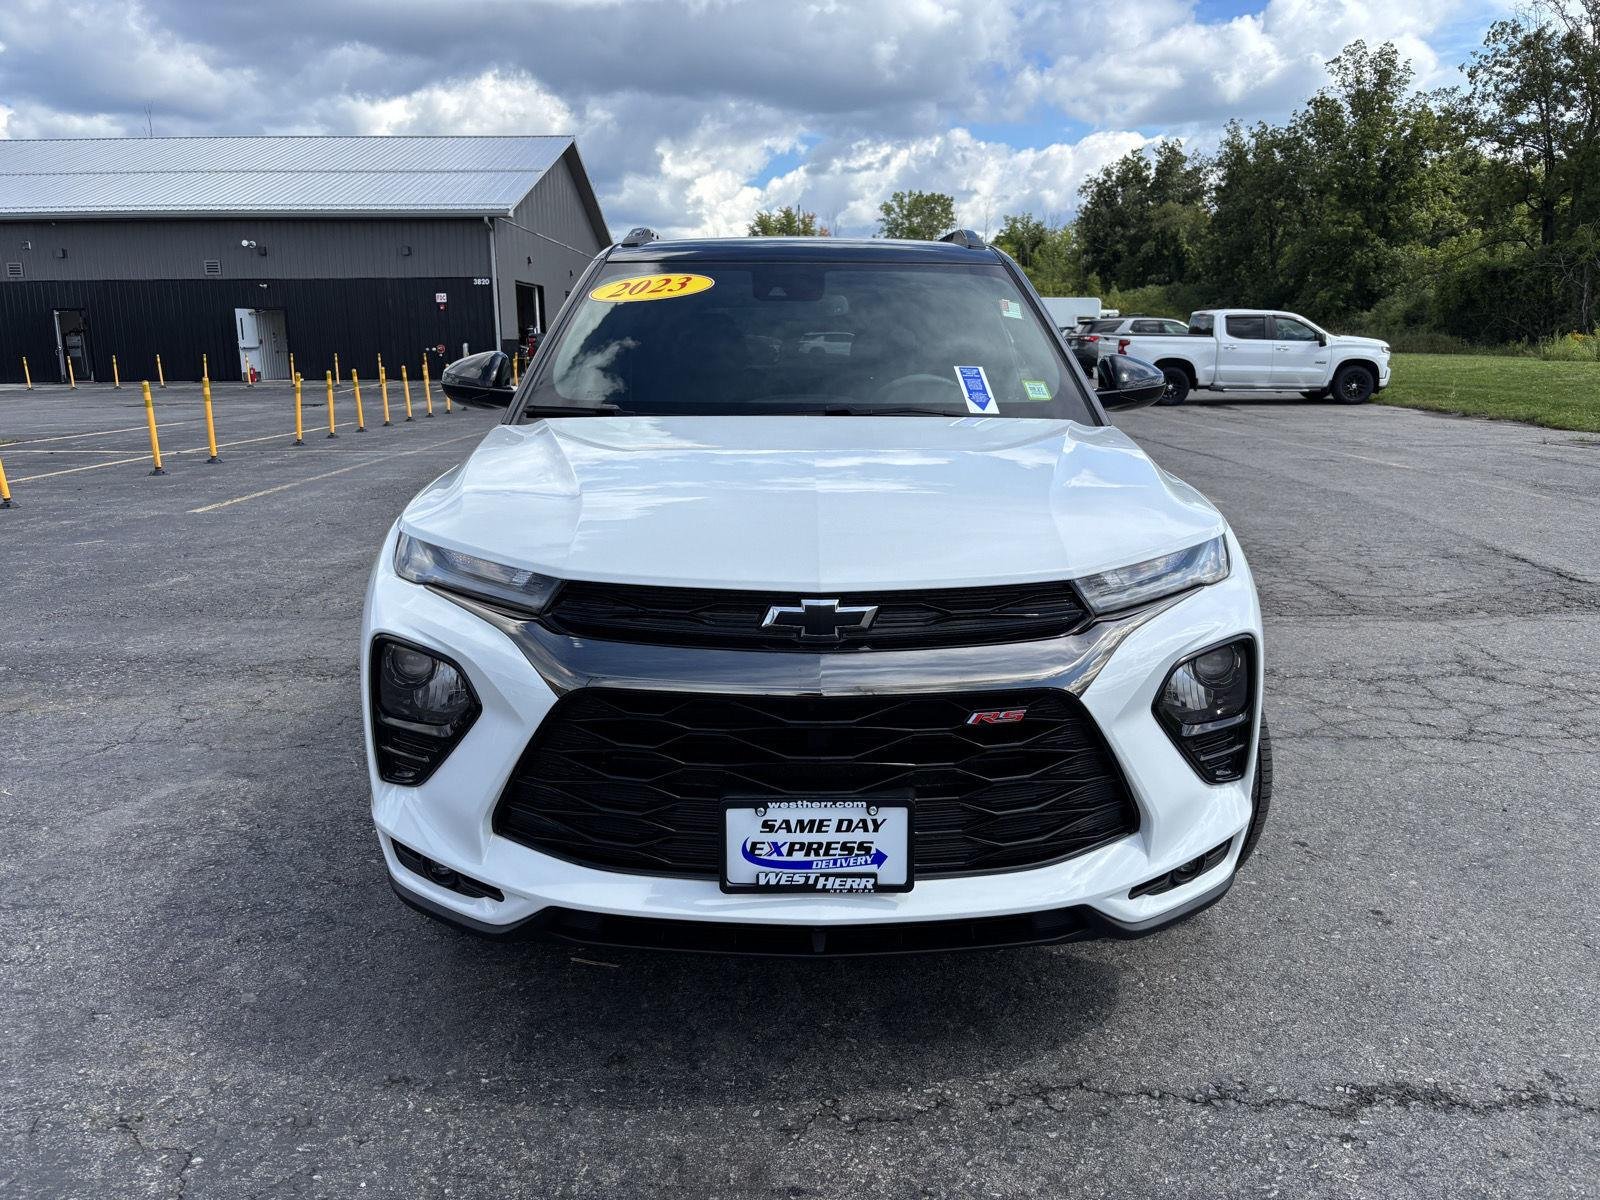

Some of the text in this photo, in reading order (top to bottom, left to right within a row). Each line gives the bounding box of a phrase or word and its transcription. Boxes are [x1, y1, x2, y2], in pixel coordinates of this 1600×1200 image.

[606, 276, 692, 299] 2023
[966, 709, 1027, 724] RS
[767, 800, 867, 809] westherr.com
[760, 818, 887, 834] SAME DAY
[748, 840, 874, 857] EXPRESS
[812, 854, 874, 869] DELIVERY
